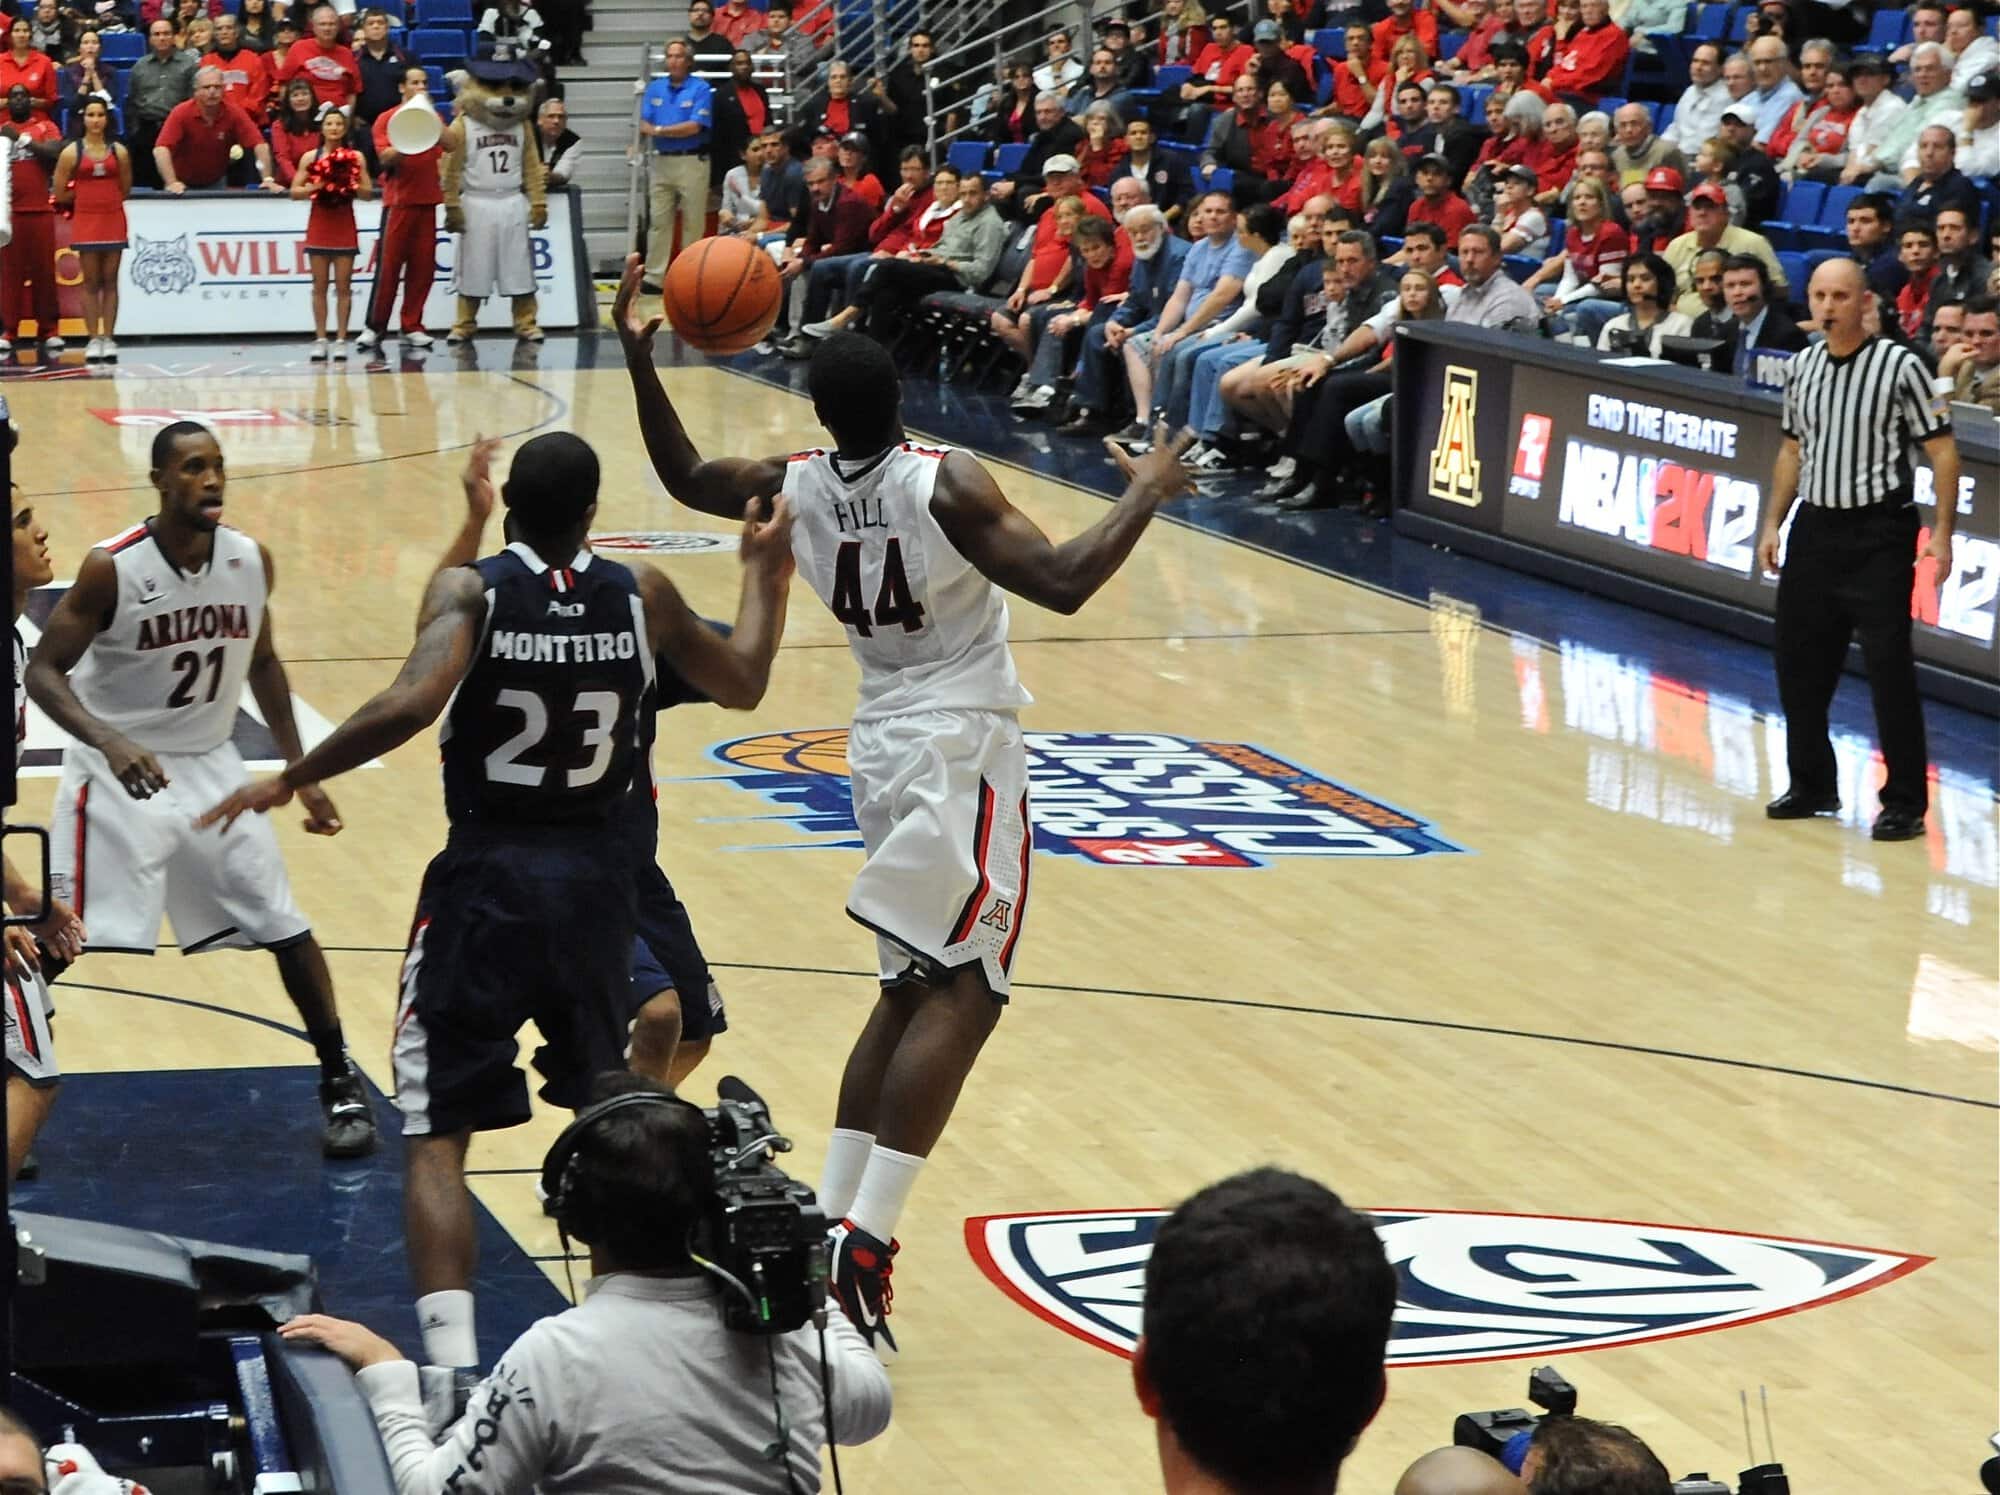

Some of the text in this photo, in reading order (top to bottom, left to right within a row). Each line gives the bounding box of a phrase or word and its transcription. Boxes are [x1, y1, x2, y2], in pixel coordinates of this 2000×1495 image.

[489, 150, 509, 174] 12
[1757, 355, 1786, 388] POS
[1588, 393, 1738, 458] END THE DEBATE
[834, 498, 889, 533] HILL
[1558, 440, 1640, 538] NBA
[832, 537, 925, 638] 44
[1911, 527, 2000, 642] K12
[136, 604, 250, 651] ARIZONA
[490, 630, 635, 663] MONTEIRO
[166, 645, 225, 709] 21
[485, 688, 620, 788] 23
[1023, 733, 1417, 855] CLASSIC
